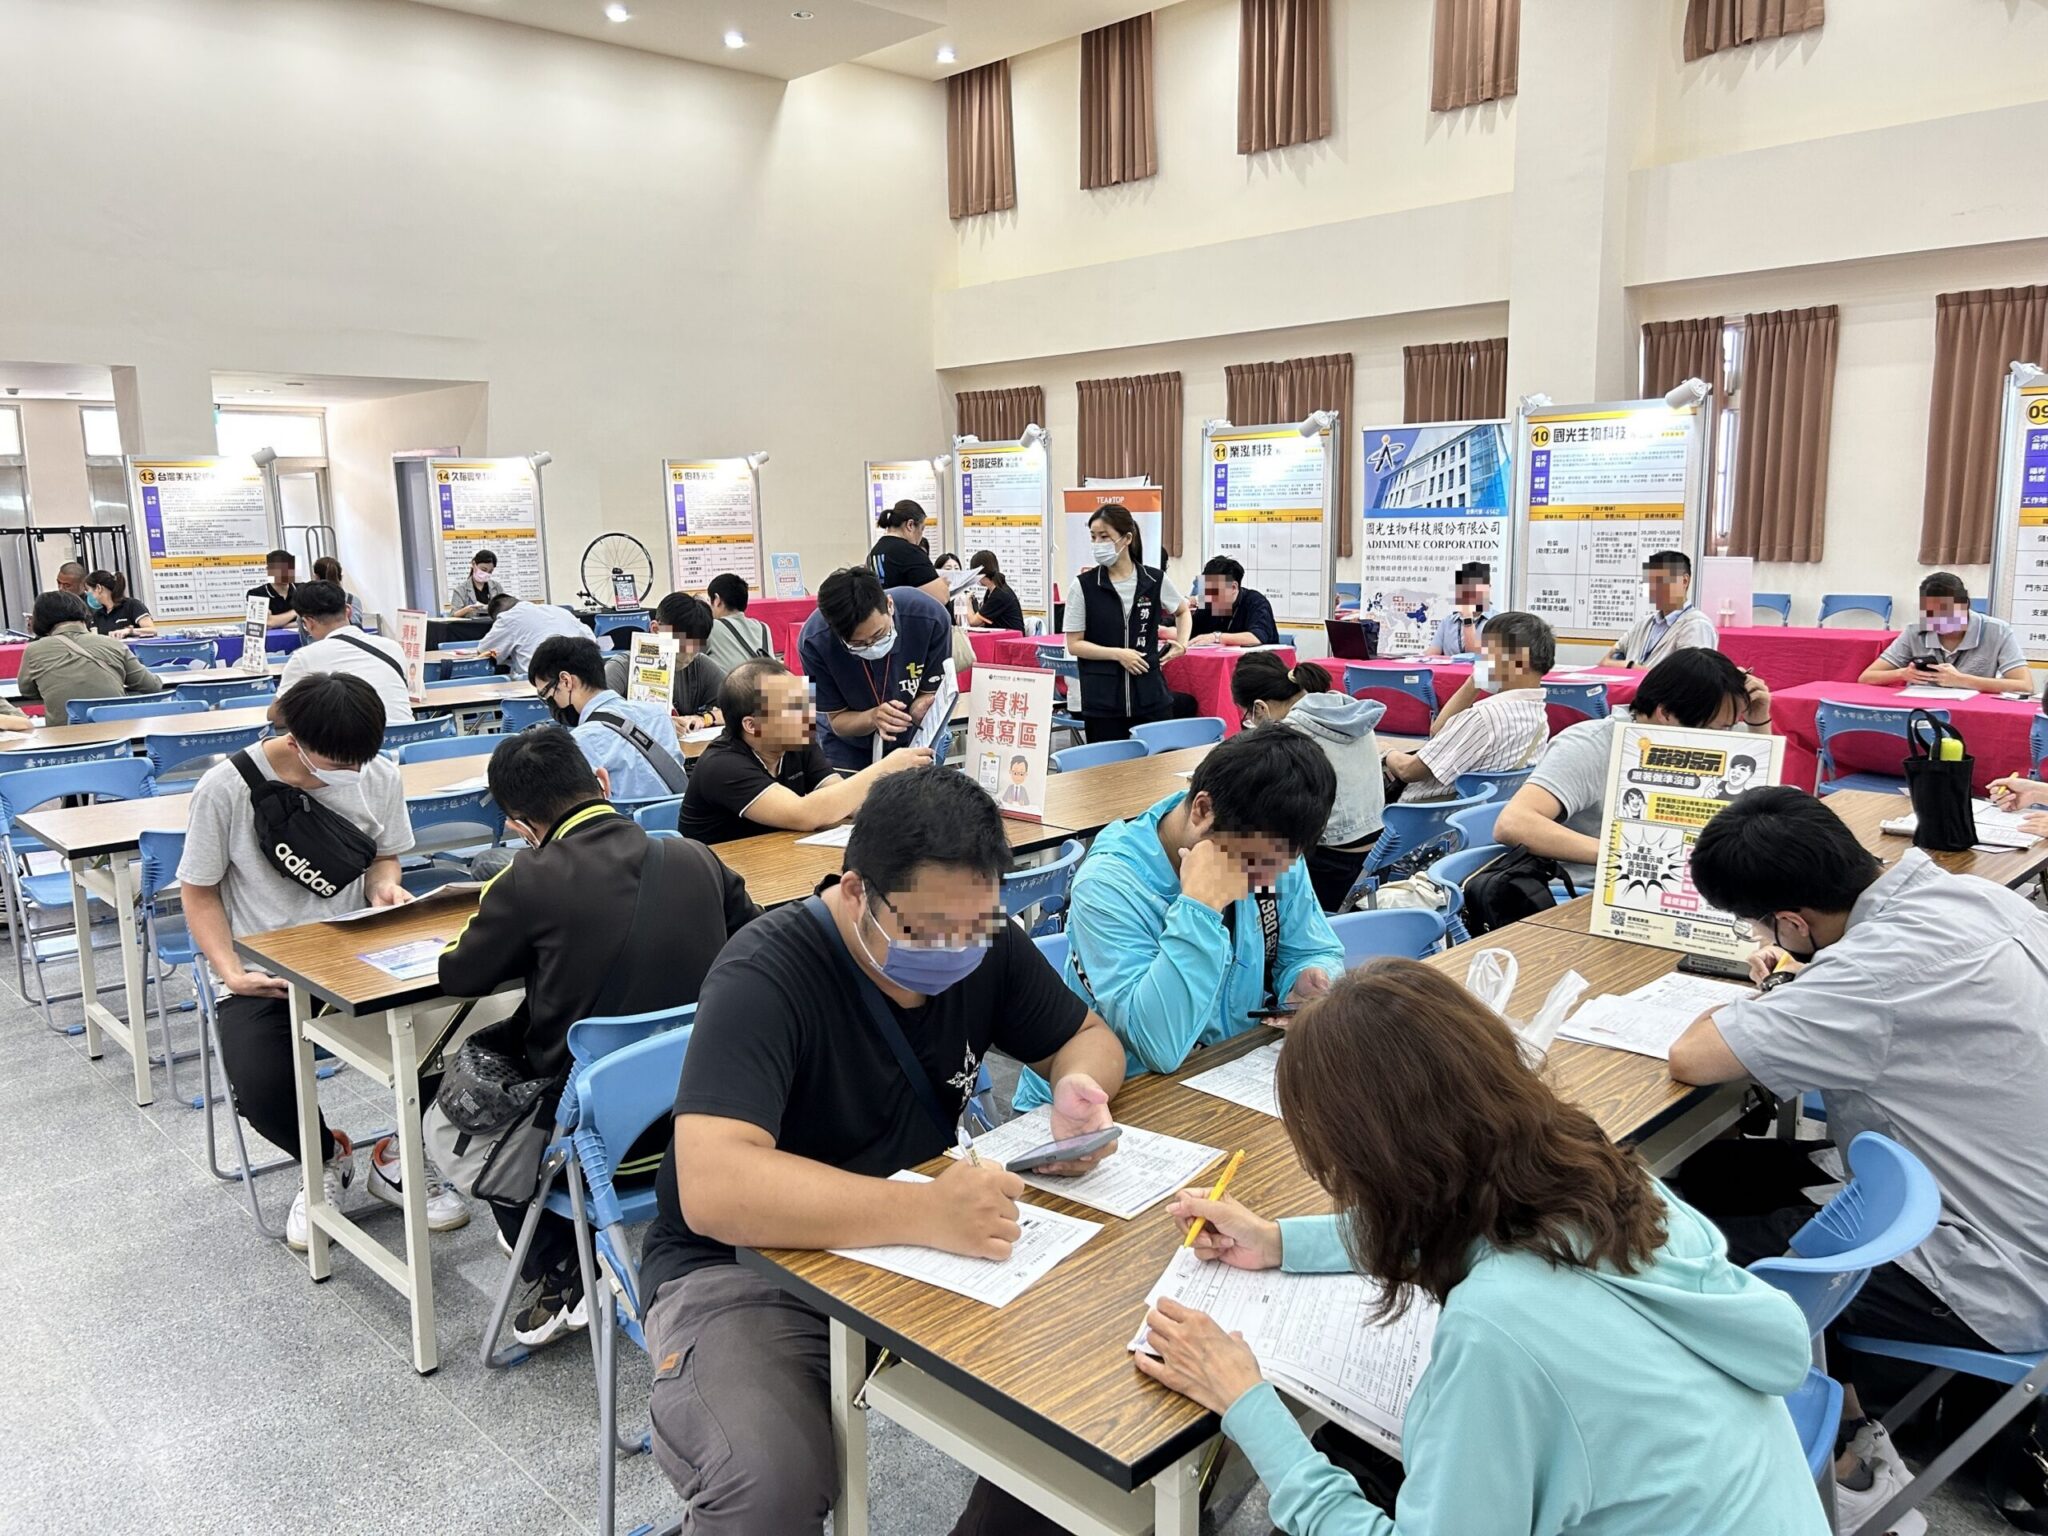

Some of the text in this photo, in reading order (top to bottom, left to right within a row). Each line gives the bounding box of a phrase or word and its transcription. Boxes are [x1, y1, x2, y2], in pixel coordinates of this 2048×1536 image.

[1532, 426, 1627, 443] 10 國光生物科技
[1215, 448, 1227, 457] 11
[962, 460, 971, 468] 12
[141, 473, 155, 481] 13
[1366, 521, 1501, 536] 國光生物科技股份有限公司
[1366, 540, 1499, 549] ADIMMUNE CORPORATION
[990, 690, 1030, 717] 資料
[976, 717, 1038, 748] 填寫區
[1625, 852, 1663, 865] 公開揭示或
[275, 842, 337, 897] adidas
